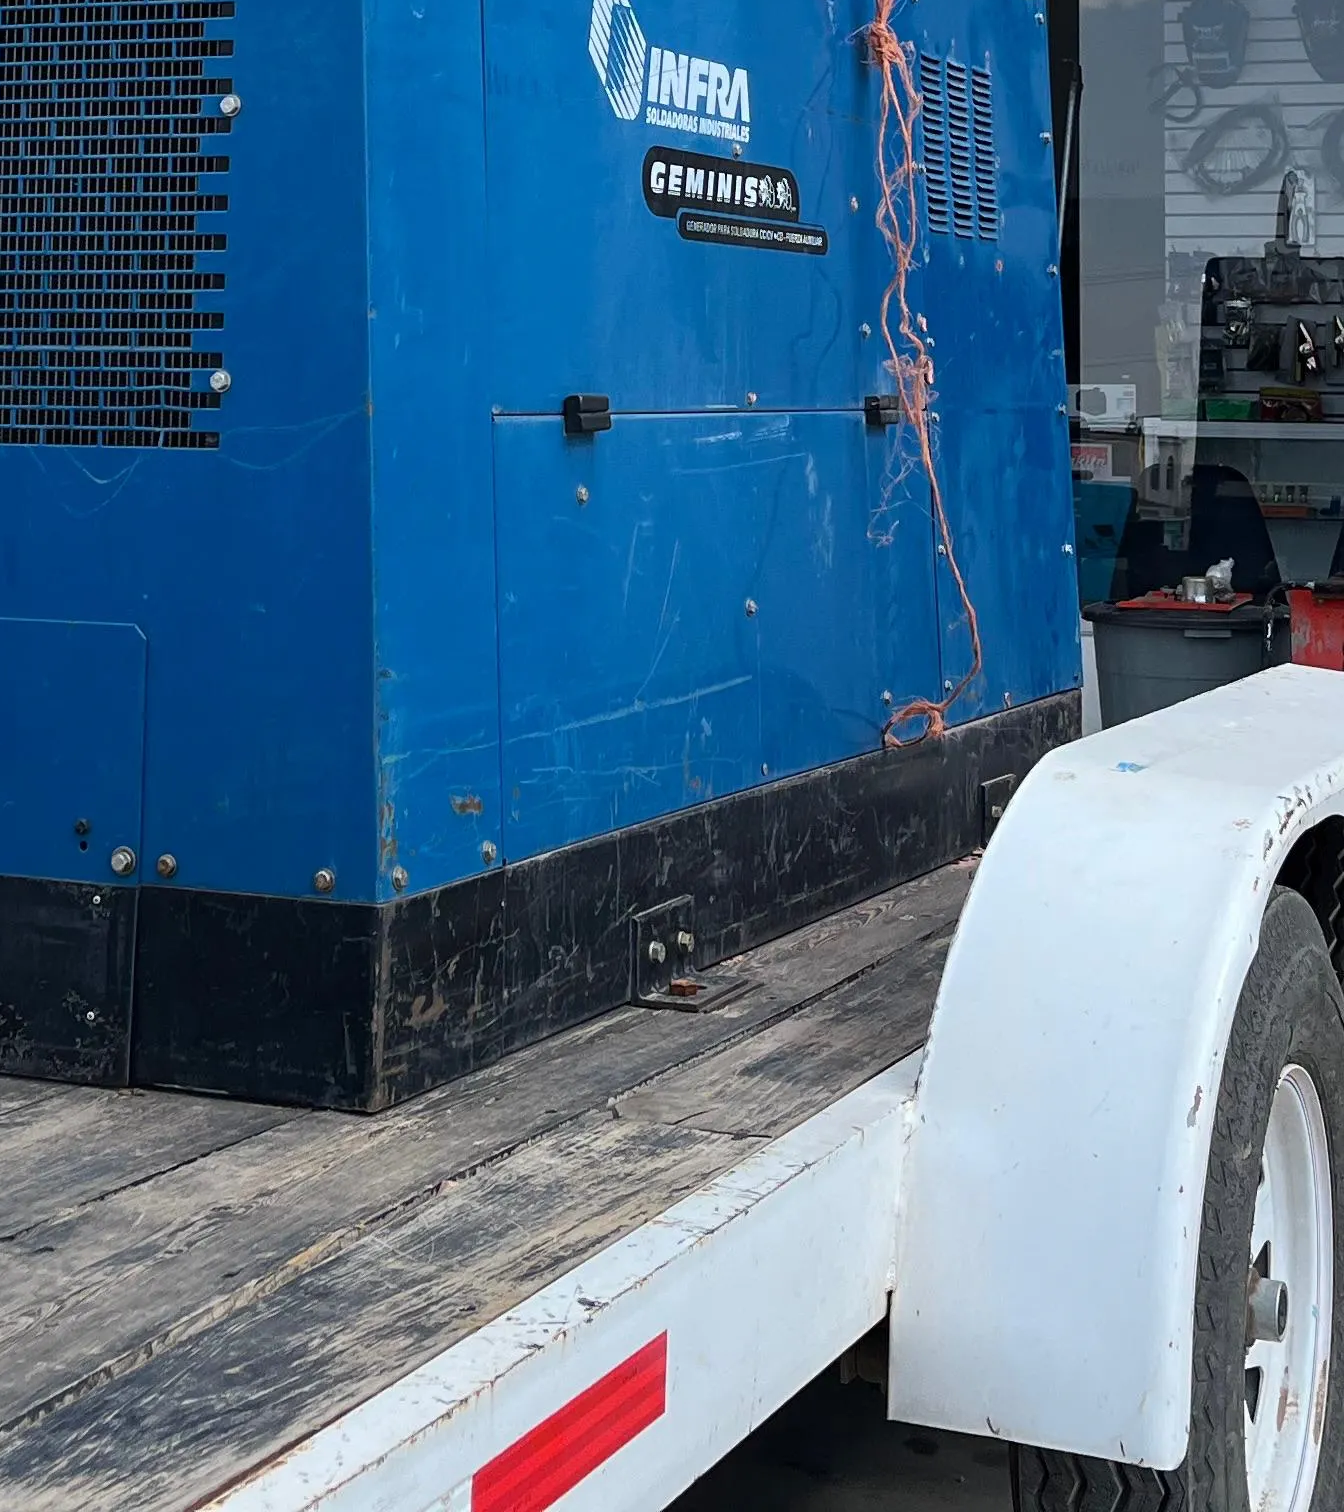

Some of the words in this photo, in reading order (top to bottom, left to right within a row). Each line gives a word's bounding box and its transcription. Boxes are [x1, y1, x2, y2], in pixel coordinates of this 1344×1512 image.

[645, 46, 751, 123] INFRA
[645, 106, 699, 134] SOLDADORAS
[699, 119, 750, 144] INDUSTRIALES
[650, 161, 759, 208] GEMINIS
